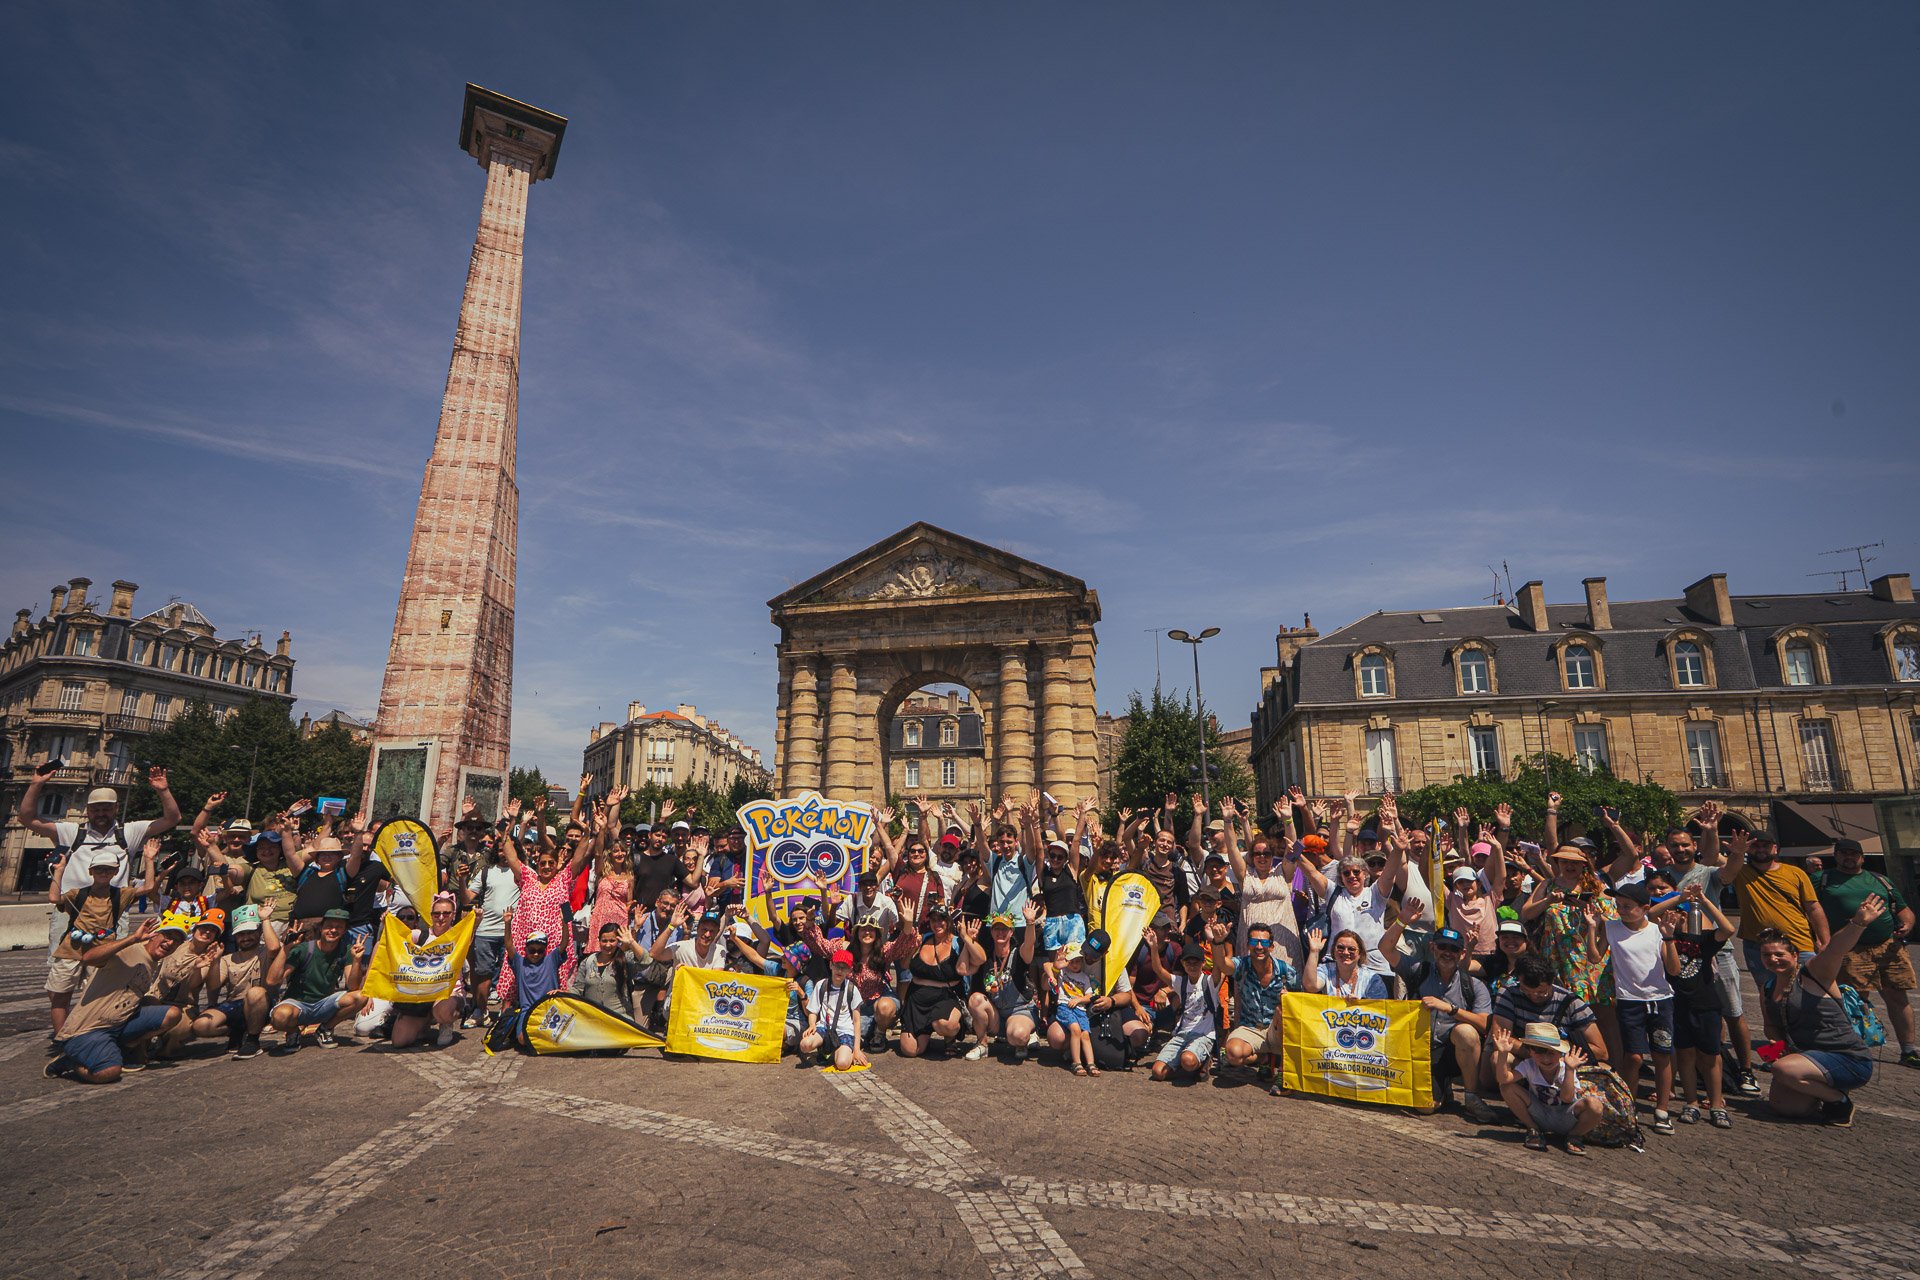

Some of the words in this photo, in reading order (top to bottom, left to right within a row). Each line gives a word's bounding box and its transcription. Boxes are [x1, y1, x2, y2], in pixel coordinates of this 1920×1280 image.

[771, 840, 844, 879] GO
[714, 998, 745, 1018] GO
[710, 1016, 744, 1028] Community
[693, 1026, 730, 1036] AMBASSADOR
[730, 1030, 756, 1041] PROGRAM
[1336, 1028, 1375, 1050] GO
[1334, 1049, 1376, 1064] Community
[1317, 1062, 1361, 1073] AMBASSADOR
[1362, 1065, 1396, 1079] PROGRAM
